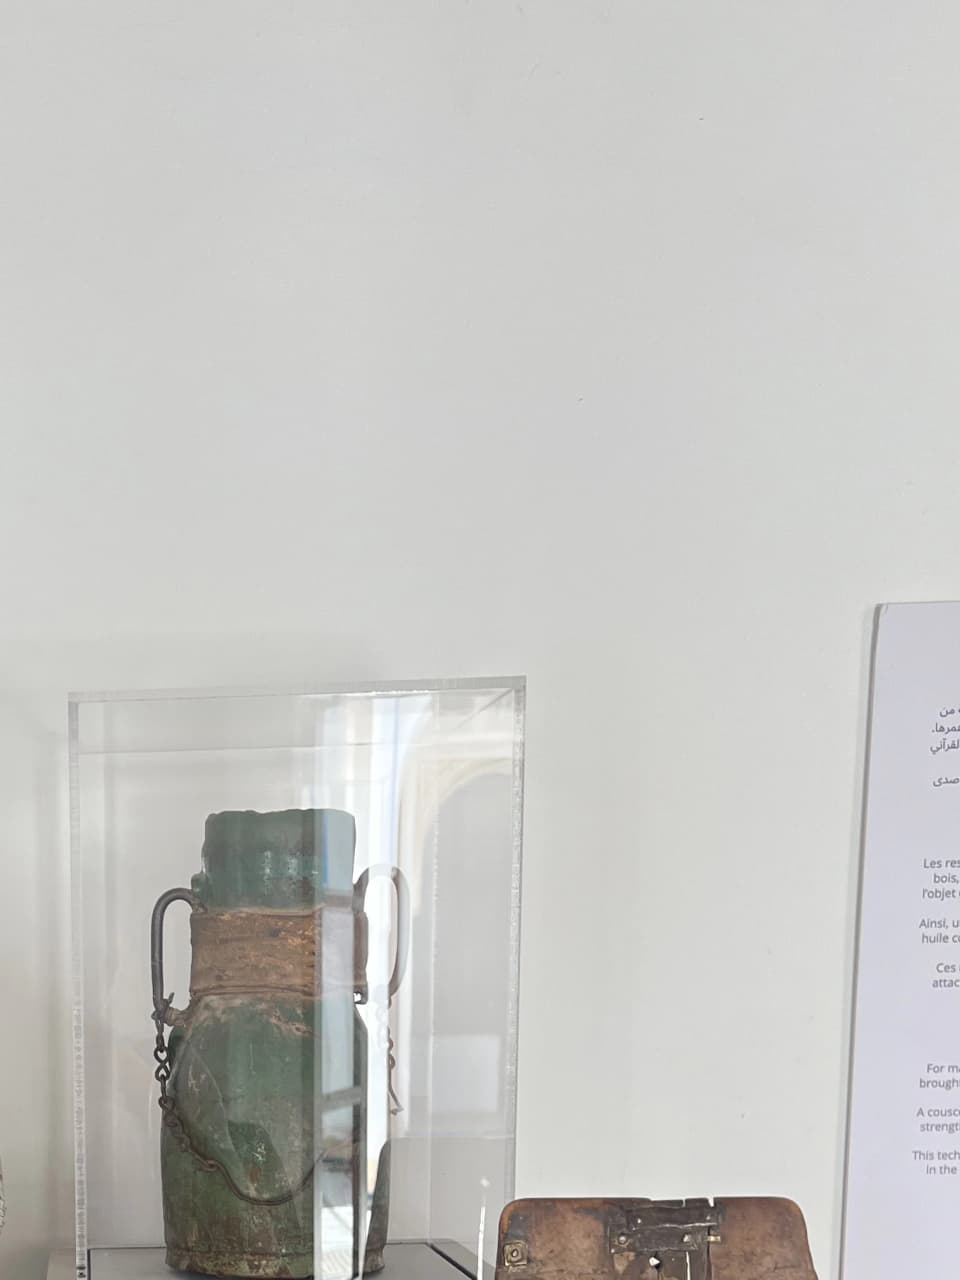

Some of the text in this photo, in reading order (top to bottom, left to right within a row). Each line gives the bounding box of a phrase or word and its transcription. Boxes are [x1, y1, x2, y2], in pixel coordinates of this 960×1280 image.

[923, 858, 942, 869] Les
[933, 872, 959, 885] bois,
[922, 887, 956, 901] l'objet
[918, 918, 949, 930] Ainsi,
[921, 932, 949, 944] huile
[936, 962, 956, 974] Ces
[926, 1063, 945, 1074] For
[916, 1107, 960, 1117] A cousc
[912, 1150, 934, 1161] This
[939, 1163, 957, 1175] the
